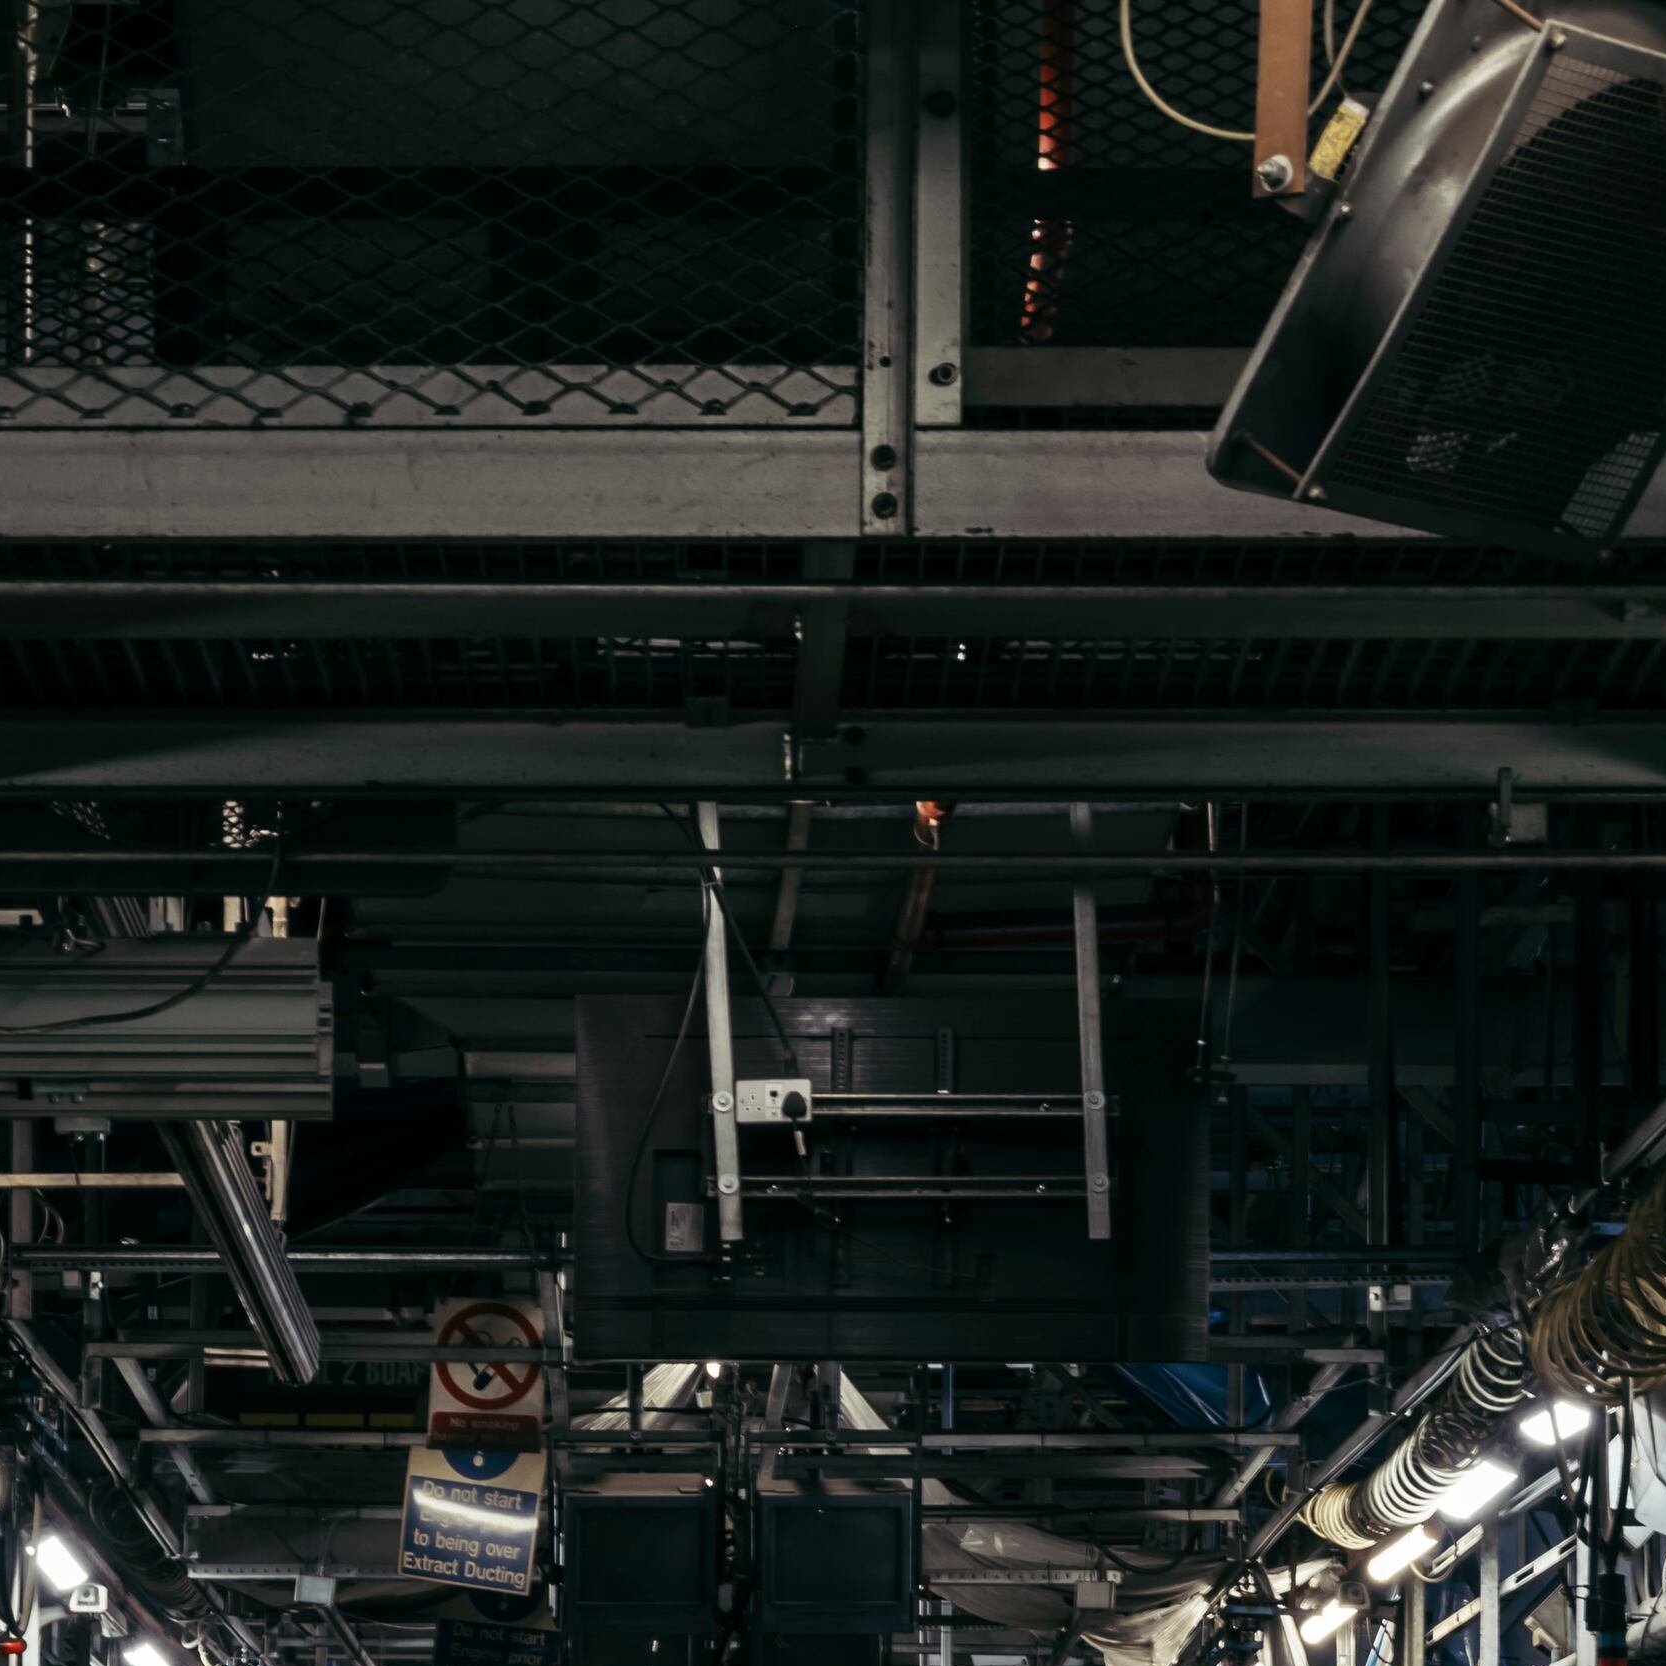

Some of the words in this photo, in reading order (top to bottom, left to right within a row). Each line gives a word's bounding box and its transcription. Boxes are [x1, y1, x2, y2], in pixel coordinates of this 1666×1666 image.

[449, 1417, 466, 1428] No
[472, 1418, 520, 1432] smoking
[423, 1480, 445, 1498] Do
[451, 1487, 478, 1503] not
[484, 1492, 522, 1510] start
[413, 1528, 429, 1545] to
[436, 1531, 479, 1557] being
[486, 1542, 521, 1559] over
[402, 1552, 458, 1576] Extract
[464, 1561, 526, 1588] Ducting
[452, 1622, 474, 1638] Do
[479, 1628, 505, 1641] not
[509, 1631, 546, 1647] start
[450, 1642, 504, 1662] Engine
[508, 1651, 543, 1666] prior
